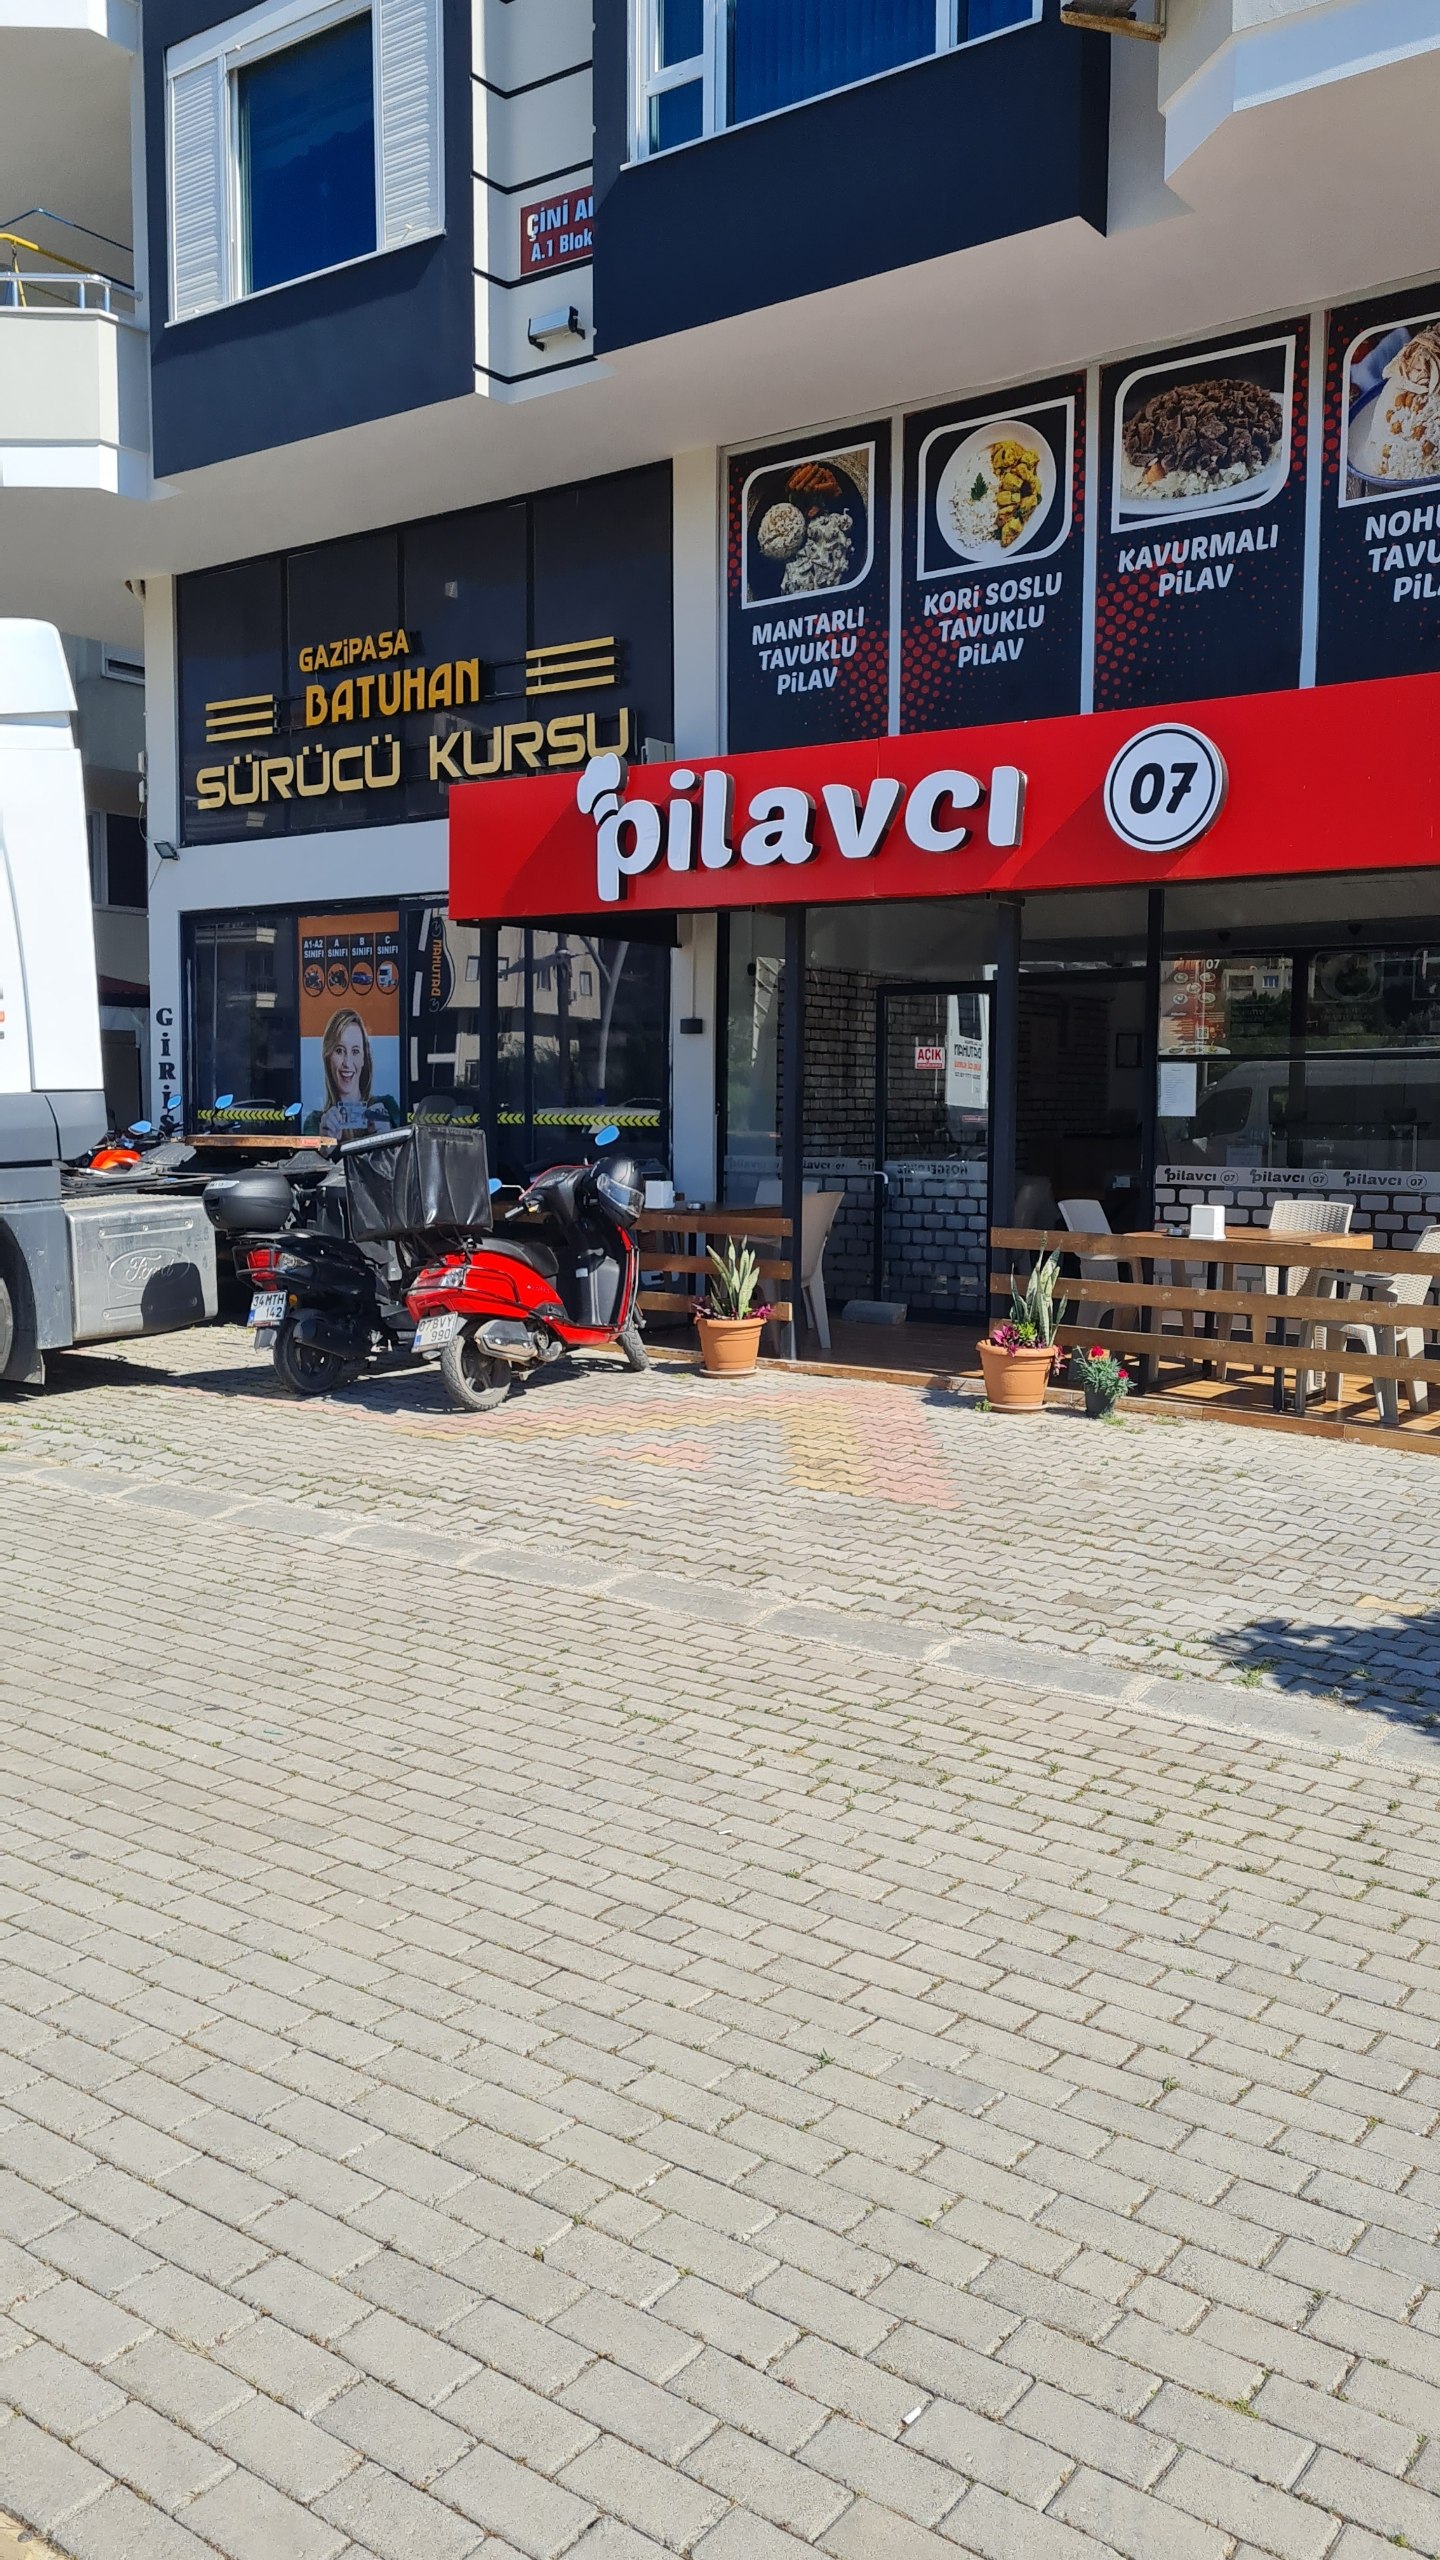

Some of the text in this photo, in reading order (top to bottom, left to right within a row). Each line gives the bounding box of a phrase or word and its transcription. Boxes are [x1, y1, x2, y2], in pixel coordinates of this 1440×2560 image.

[526, 199, 569, 242] ÇİNİ
[559, 228, 593, 254] Blok
[1117, 524, 1280, 574] KAVURMALI
[984, 571, 1063, 606] SOSLU
[751, 605, 865, 646] MANTARLI
[937, 604, 1046, 643] TAVUKLU
[758, 635, 857, 672] TAVUKLU
[305, 658, 480, 728] BATUHAN
[196, 707, 630, 811] SÜRÜCÜ KURSU
[590, 763, 1198, 902] pilavcı 07
[334, 939, 340, 947] A
[359, 937, 365, 946] B
[384, 935, 391, 944] C
[304, 949, 324, 959] SINIFI
[328, 948, 348, 957] SINIFI
[351, 946, 373, 956] SINIFI
[377, 945, 399, 955] SINIFI
[1206, 959, 1220, 969] 07
[917, 1047, 942, 1063] AÇIK
[1166, 1170, 1217, 1183] pilavcı
[1252, 1171, 1305, 1184] pilavcı
[1345, 1172, 1402, 1187] pilavcı
[126, 1254, 175, 1282] Ford
[266, 1307, 283, 1318] 142
[431, 1329, 451, 1341] 990
